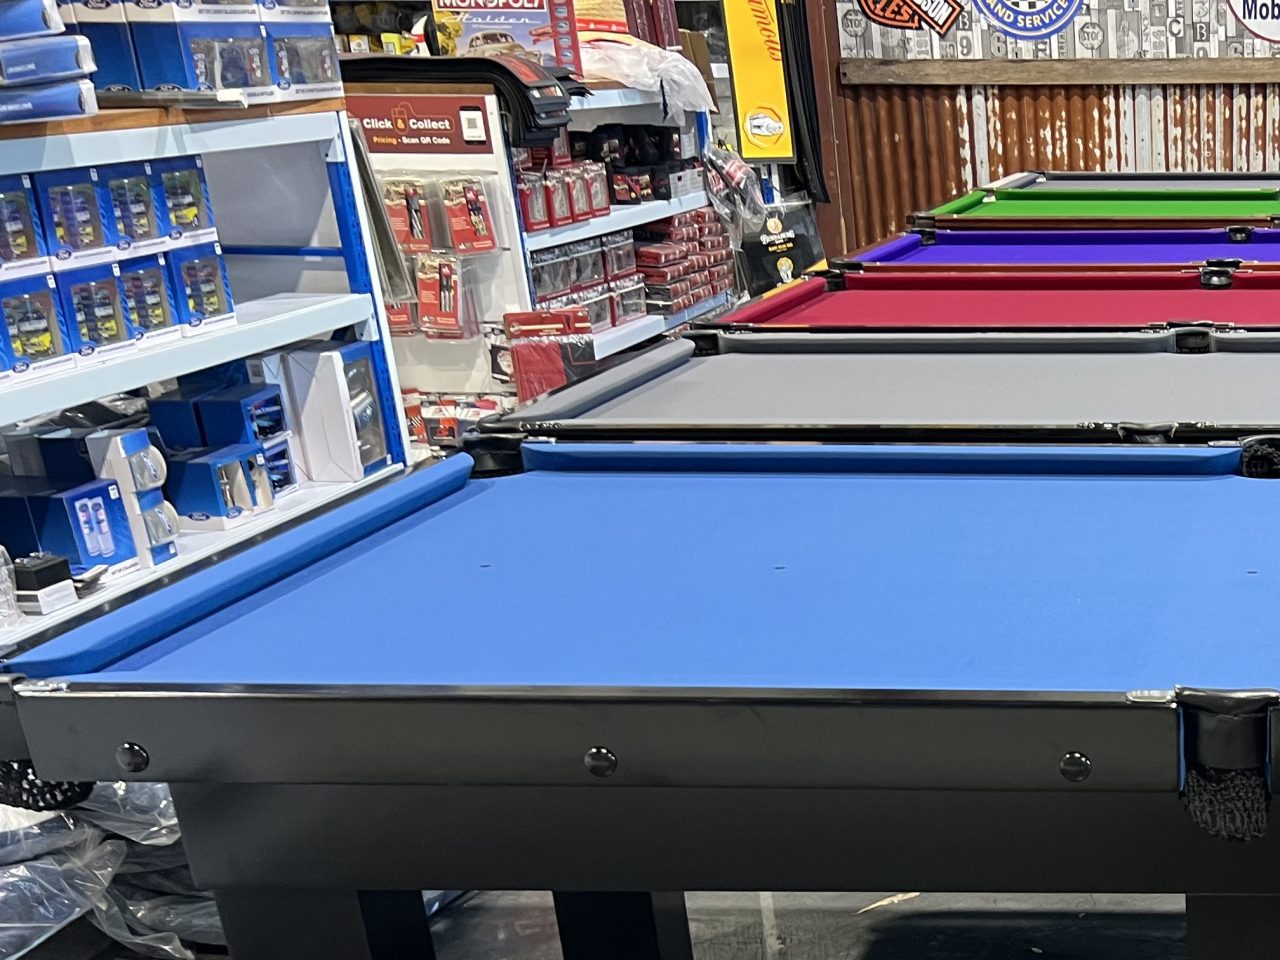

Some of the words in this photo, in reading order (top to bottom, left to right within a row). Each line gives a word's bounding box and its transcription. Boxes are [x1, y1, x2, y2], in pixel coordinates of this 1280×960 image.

[1016, 0, 1069, 28] SERVICE
[362, 118, 394, 129] Click
[408, 118, 451, 130] Collect
[372, 136, 398, 145] Pricing
[402, 136, 420, 145] Scan
[420, 136, 432, 145] QR
[432, 136, 451, 145] Code
